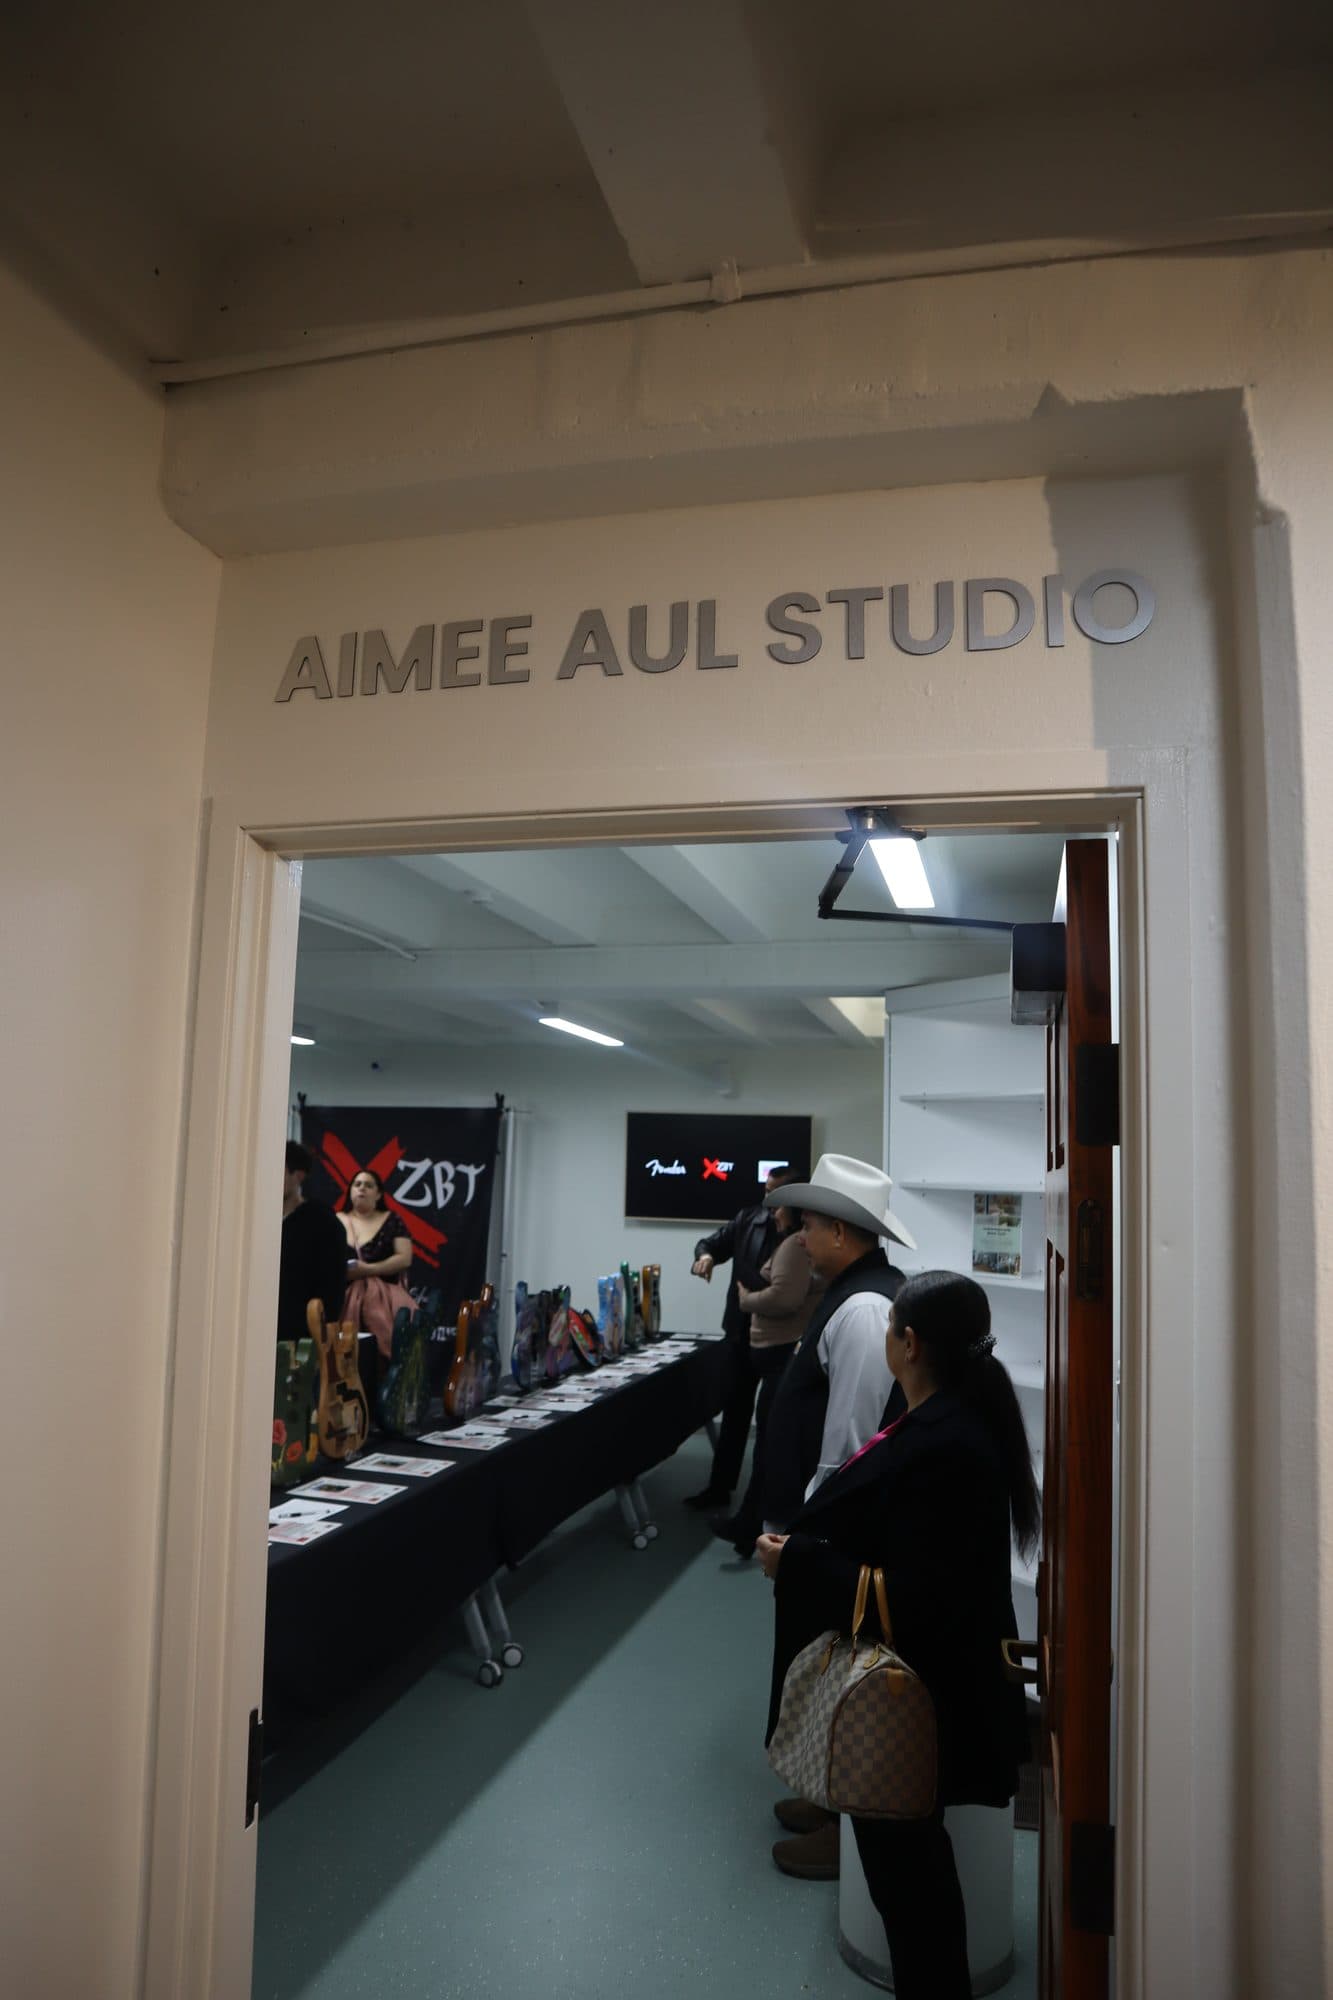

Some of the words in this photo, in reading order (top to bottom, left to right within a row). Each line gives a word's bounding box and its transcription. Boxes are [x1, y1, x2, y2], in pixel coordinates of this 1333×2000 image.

[275, 614, 532, 703] AIMEE
[556, 599, 738, 680] AUL
[766, 569, 1157, 664] STUDIO
